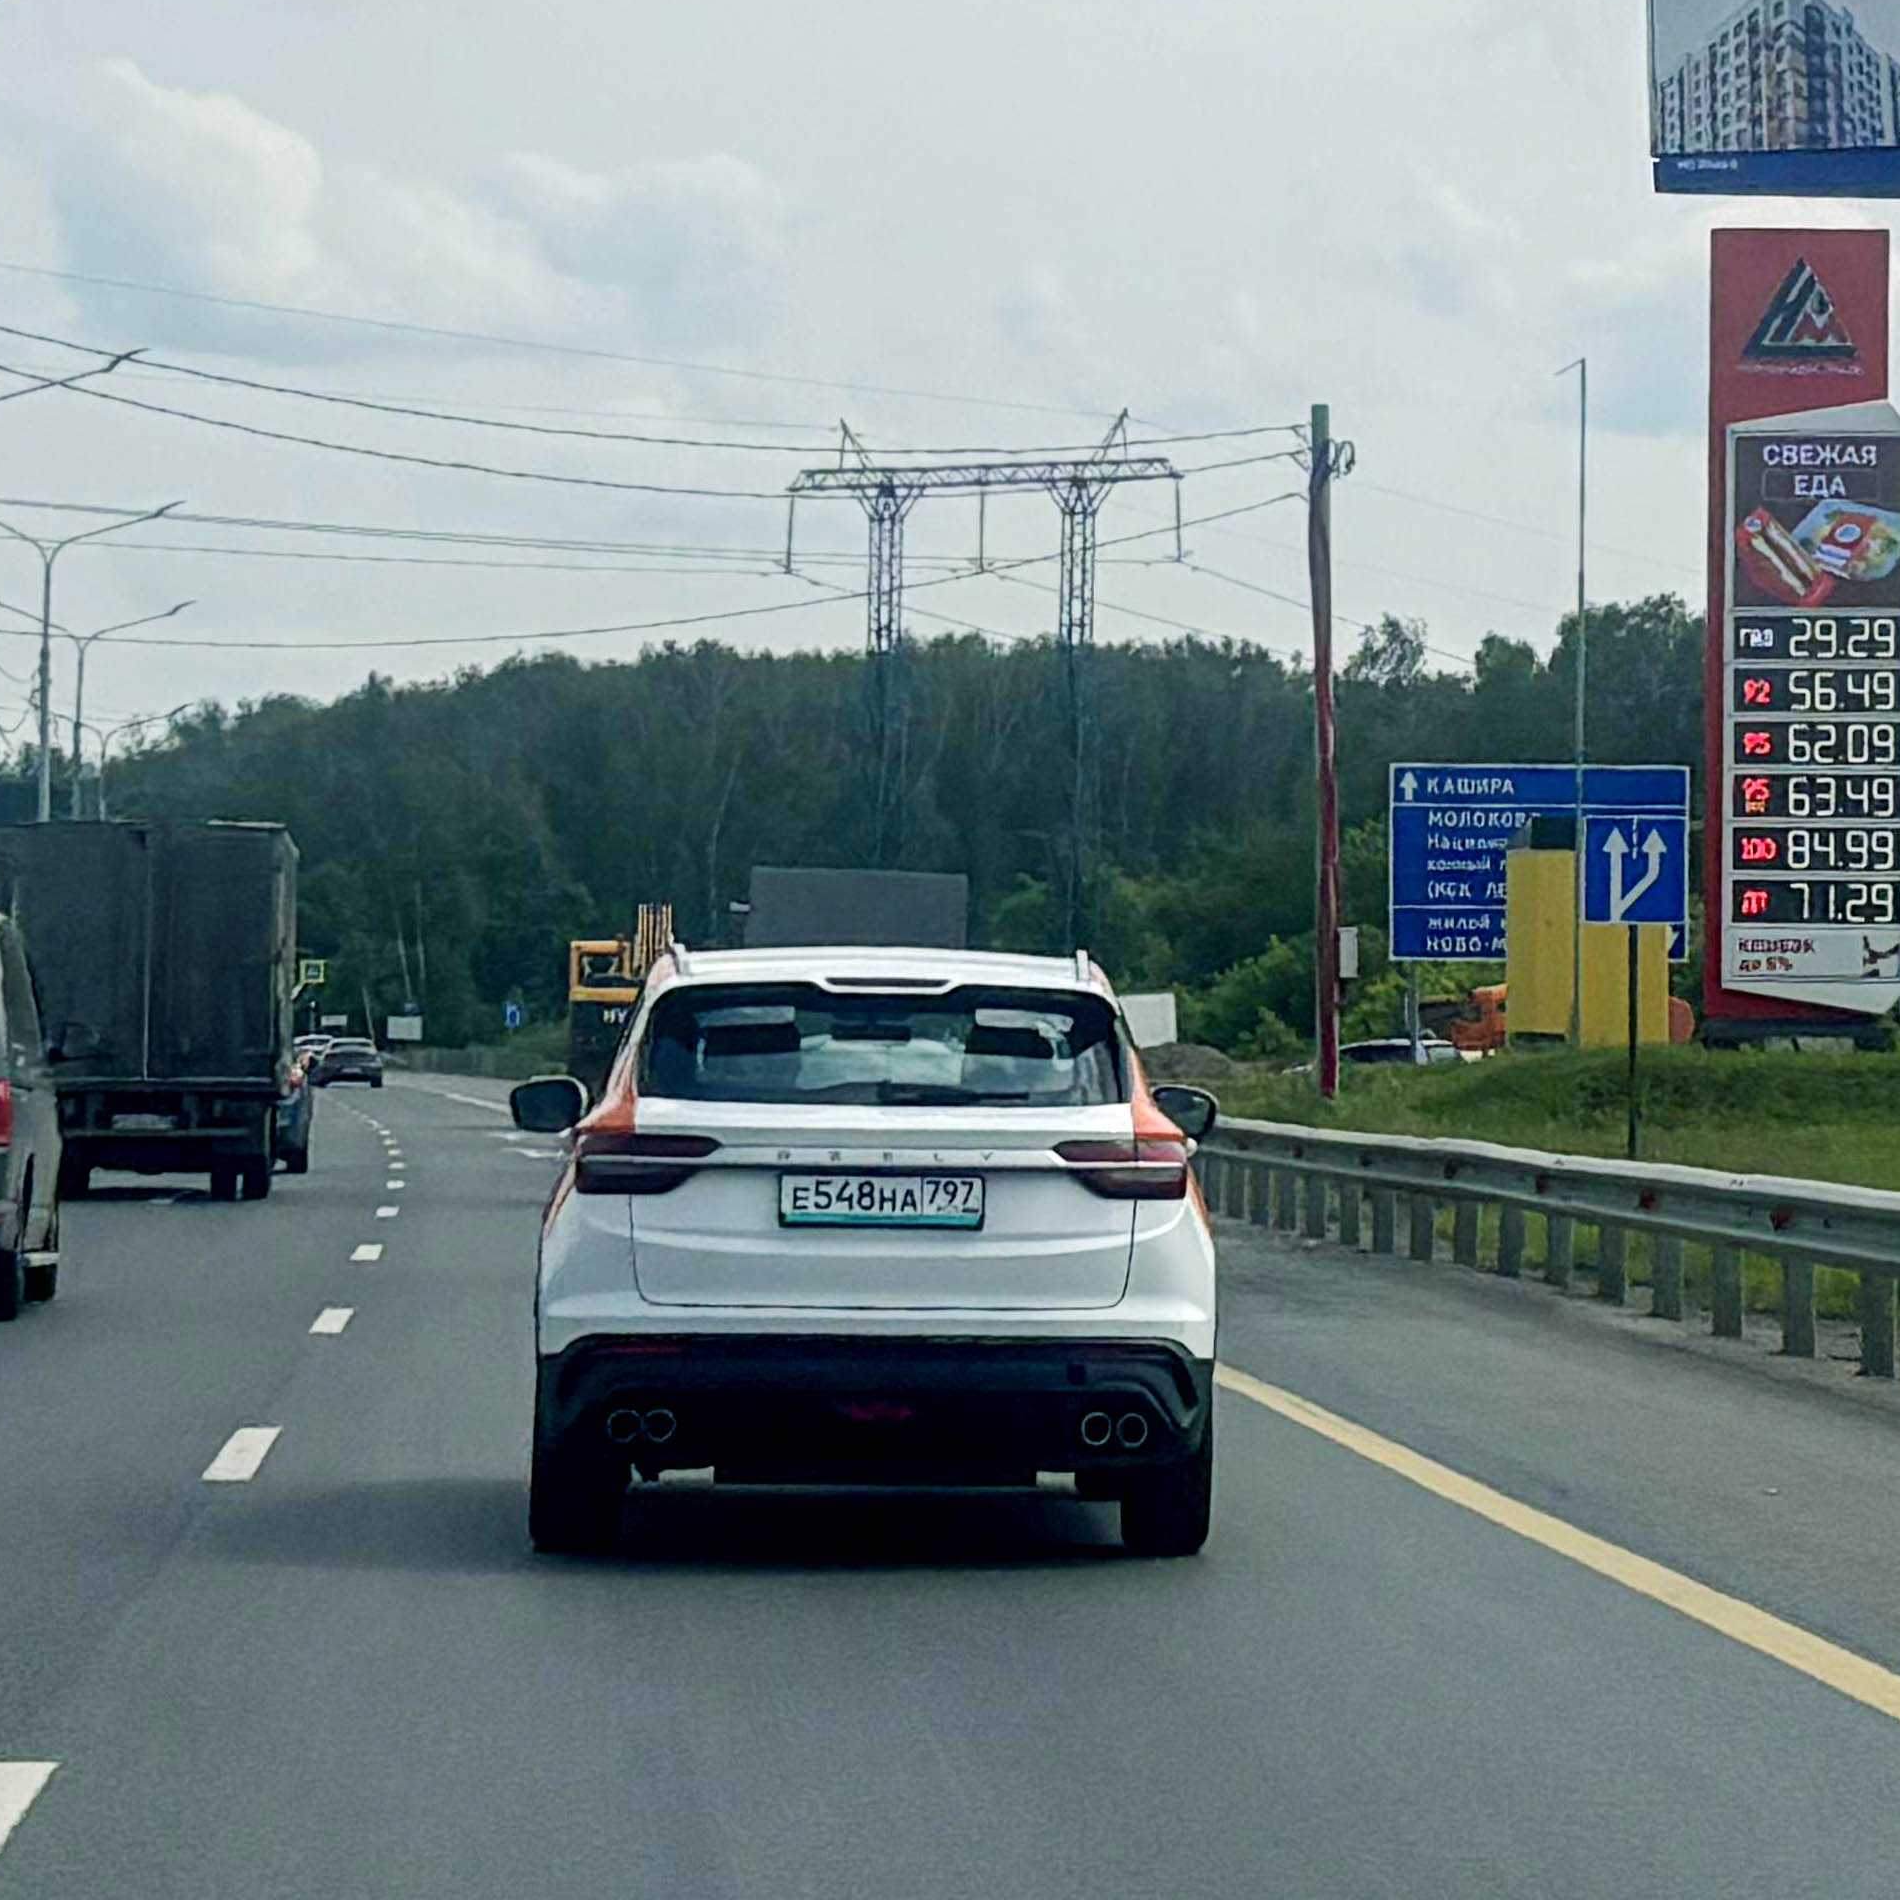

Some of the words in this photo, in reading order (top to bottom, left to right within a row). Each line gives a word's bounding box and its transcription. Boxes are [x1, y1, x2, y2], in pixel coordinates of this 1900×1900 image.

[1762, 444, 1877, 466] СВЕЖАЯ
[1794, 474, 1846, 497] ЕДА
[1789, 618, 1895, 657] 29.29
[1743, 678, 1772, 704] 92
[1789, 671, 1895, 710] 56.49
[1743, 732, 1772, 755] 95
[1788, 724, 1894, 763] 62.09
[1427, 777, 1515, 795] КАШИРА
[1788, 777, 1894, 816] 63.49
[1428, 809, 1541, 828] МОЛОКОВ
[1741, 838, 1777, 860] 100
[1787, 830, 1894, 869] 84.99
[1789, 883, 1893, 922] 71.29
